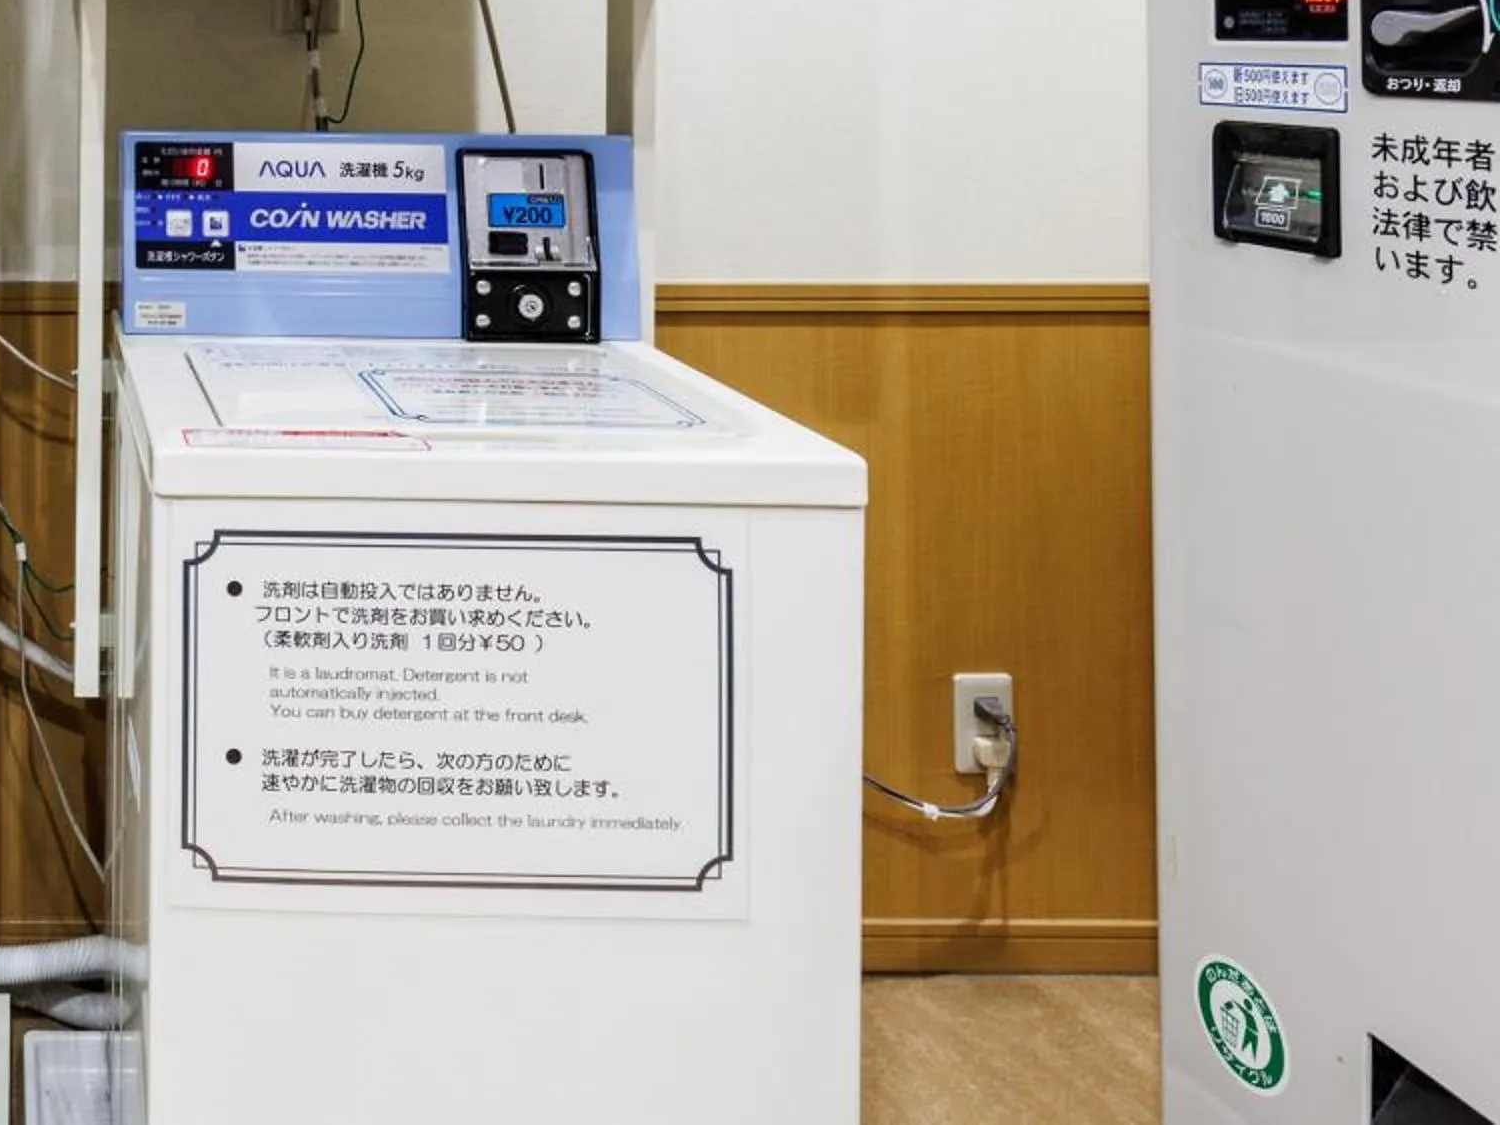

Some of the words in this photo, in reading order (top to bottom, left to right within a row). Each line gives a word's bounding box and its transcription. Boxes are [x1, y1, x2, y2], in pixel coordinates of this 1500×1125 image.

[1386, 77, 1462, 93] おつり・返却
[1371, 132, 1496, 173] 未成年者
[196, 158, 209, 176] 0
[258, 160, 327, 178] AQUA
[339, 162, 389, 179] 洗濯機
[392, 161, 425, 182] 5kg
[1373, 169, 1497, 214] および飲
[249, 202, 320, 229] COIN
[326, 210, 427, 230] WASHER
[502, 206, 553, 224] ¥200
[1372, 206, 1499, 252] 法律で禁
[1374, 246, 1478, 290] います。
[262, 580, 541, 604] 洗剤は自動投入ではありません。
[254, 606, 592, 630] フロントで洗剤をお買い求めください。
[402, 667, 480, 686] Detergent
[501, 670, 529, 684] not
[269, 685, 372, 702] automatically
[269, 703, 301, 719] You
[305, 707, 336, 720] can
[339, 705, 368, 722] buy
[372, 705, 449, 723] detergent
[474, 707, 501, 723] the
[504, 706, 544, 723] front
[261, 747, 573, 772] 洗濯が完了したら、次の方のために
[260, 773, 620, 799] 速やかに洗濯物の回収をお願い致します。
[268, 807, 309, 824] After
[387, 811, 438, 828] please
[441, 812, 493, 827] collect
[496, 813, 524, 828] the
[527, 813, 586, 831] laundry
